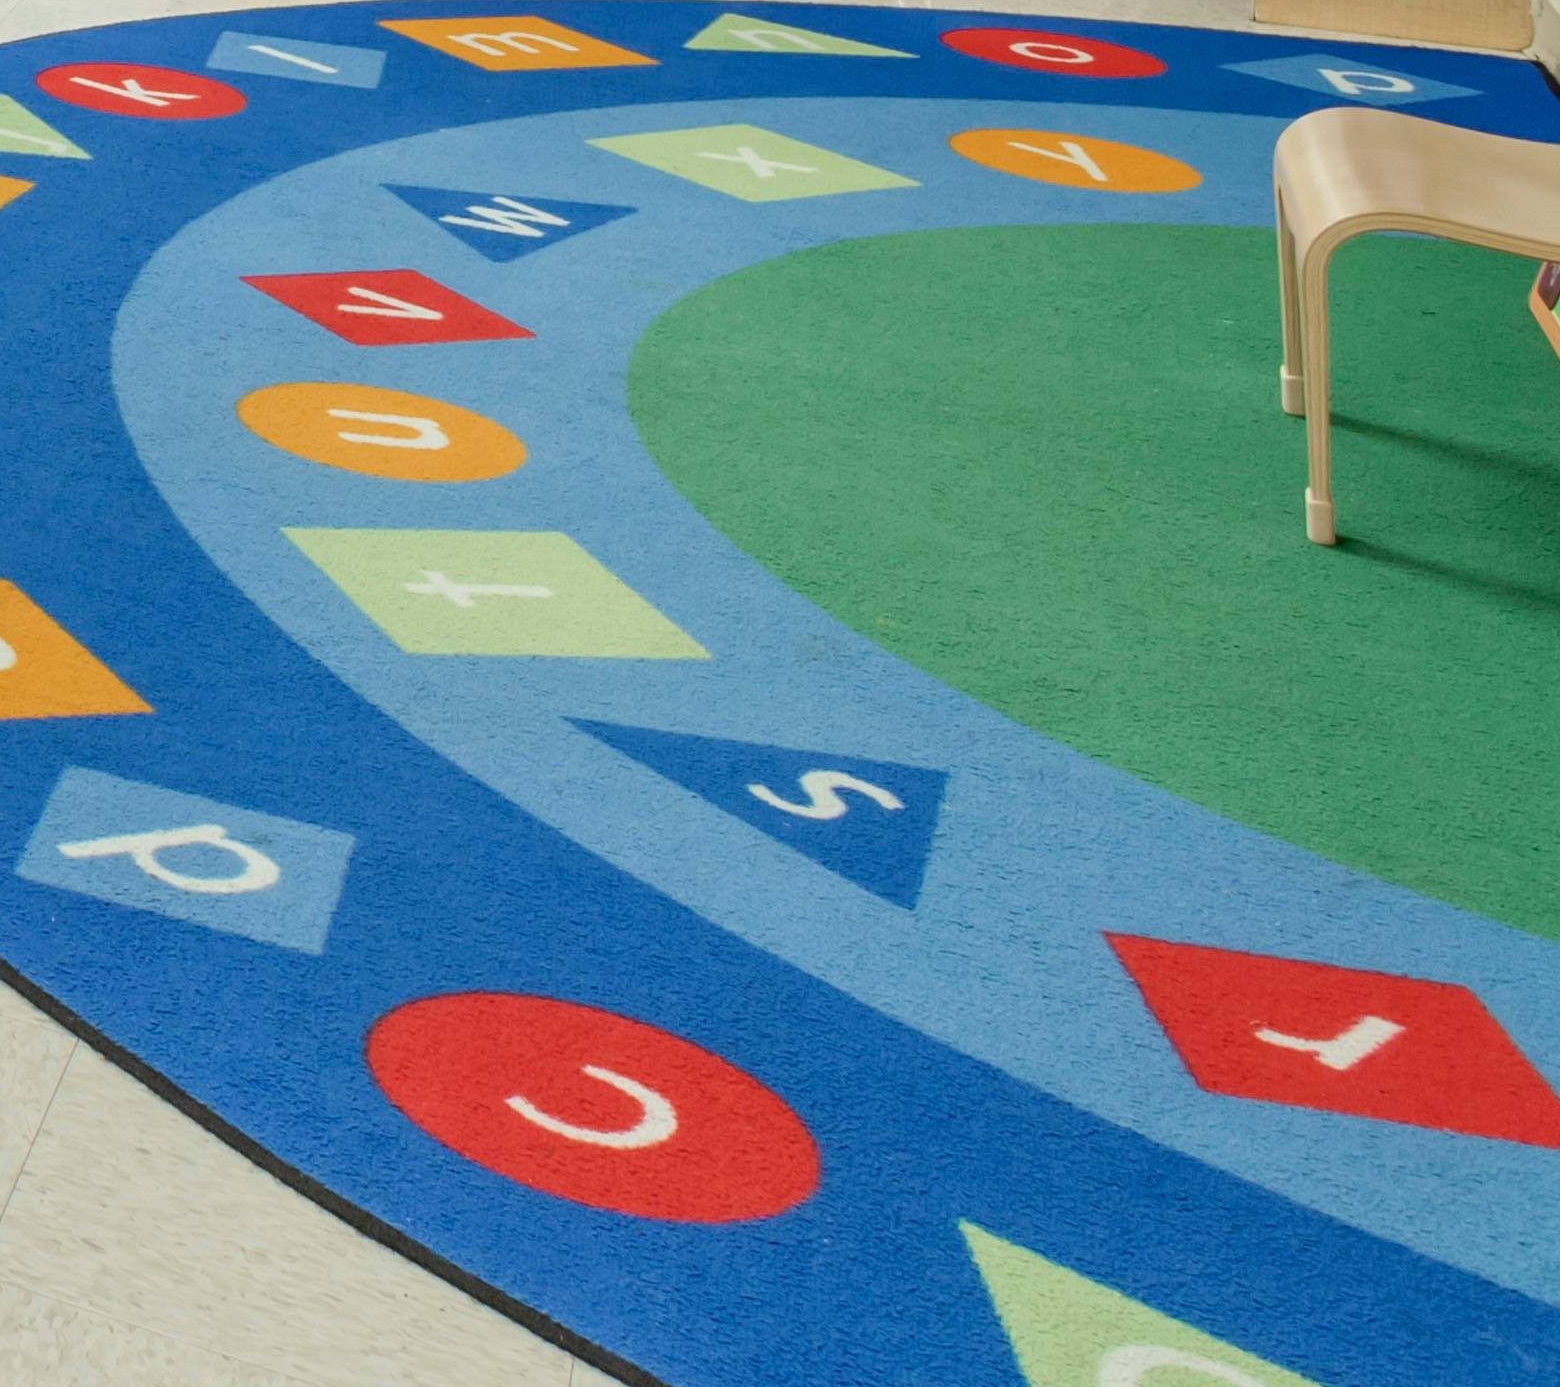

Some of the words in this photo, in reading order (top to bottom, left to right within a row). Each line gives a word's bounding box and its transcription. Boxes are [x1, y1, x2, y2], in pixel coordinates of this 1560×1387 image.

[446, 32, 579, 57] m
[1010, 41, 1094, 64] o
[71, 77, 196, 106] k
[697, 146, 817, 179] x
[1006, 141, 1107, 182] y
[439, 195, 571, 240] w
[337, 285, 445, 321] v
[405, 571, 552, 607] t
[747, 769, 906, 823] s
[1256, 1016, 1403, 1070] r
[505, 1065, 677, 1148] c
